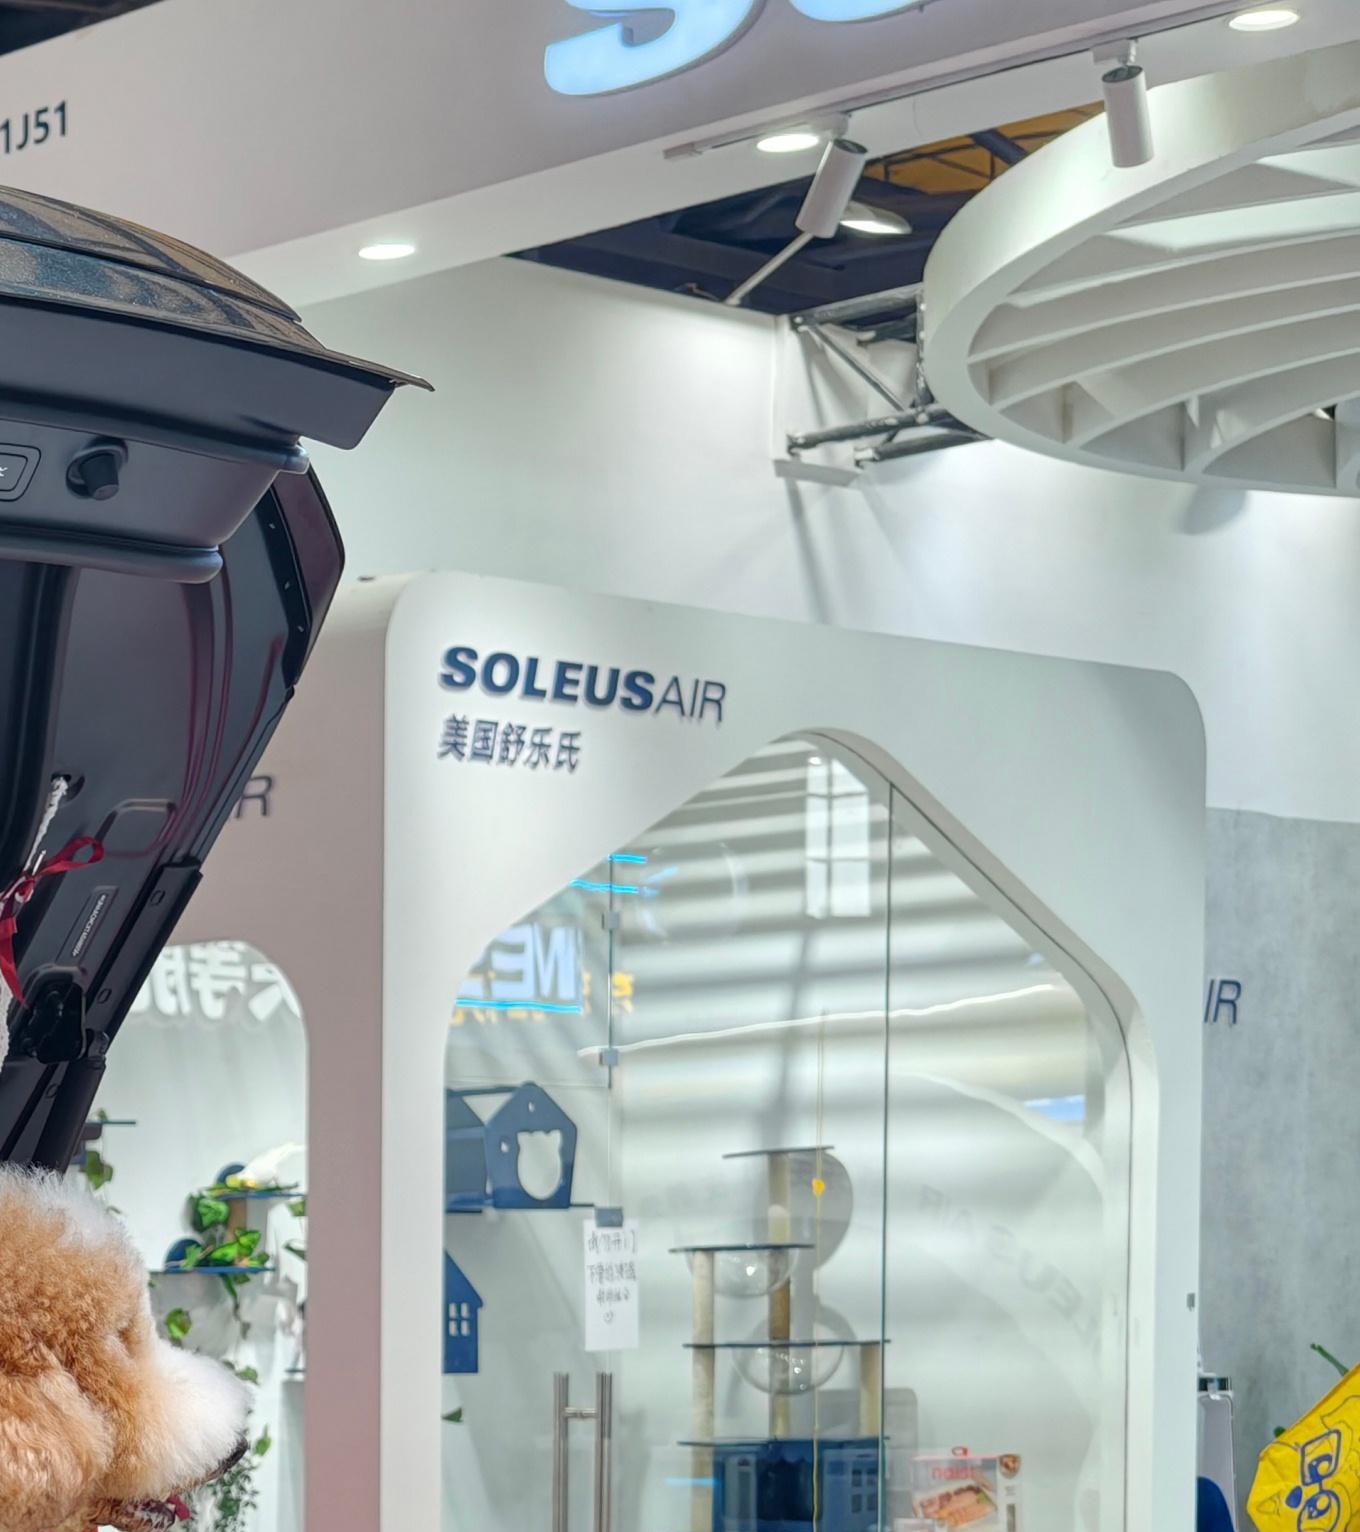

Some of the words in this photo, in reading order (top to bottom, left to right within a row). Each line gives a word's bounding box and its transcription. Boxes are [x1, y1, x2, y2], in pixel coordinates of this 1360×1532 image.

[439, 645, 728, 724] SOLEUSAIR
[438, 713, 584, 773] 美国舒乐氏
